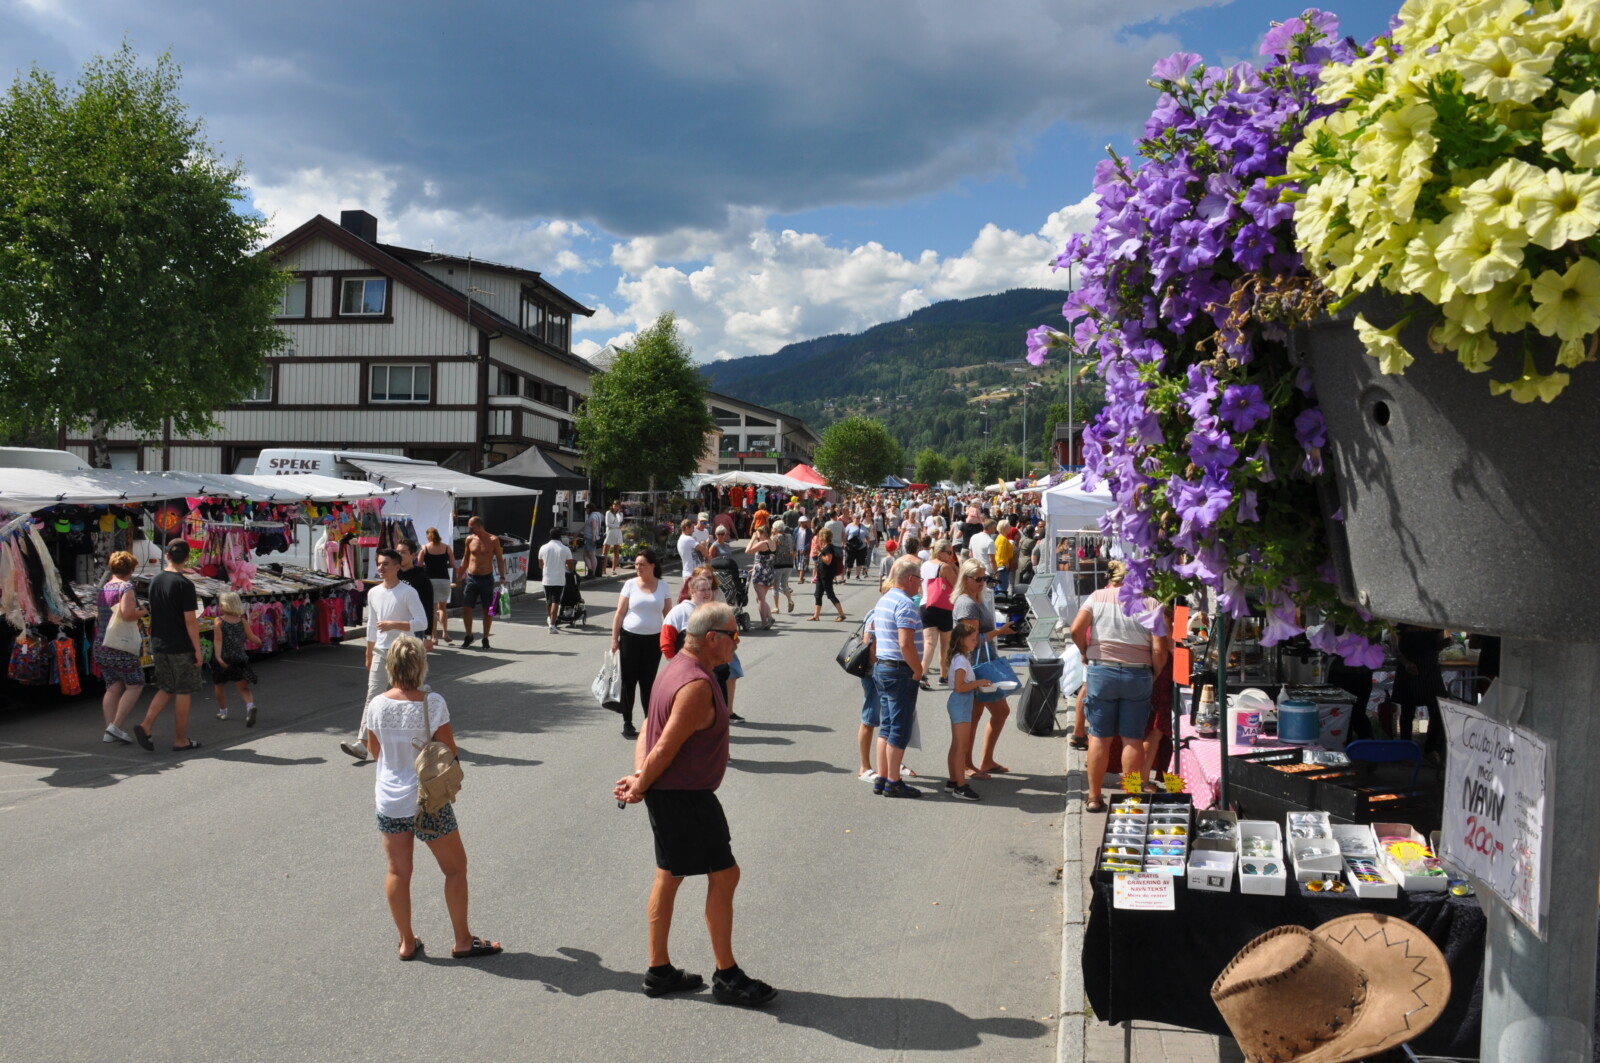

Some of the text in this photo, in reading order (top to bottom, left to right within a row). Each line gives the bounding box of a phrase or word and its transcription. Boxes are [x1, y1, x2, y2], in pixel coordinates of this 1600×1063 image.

[270, 458, 320, 470] SPEKE
[1478, 765, 1494, 783] med
[1462, 776, 1506, 827] NAVN
